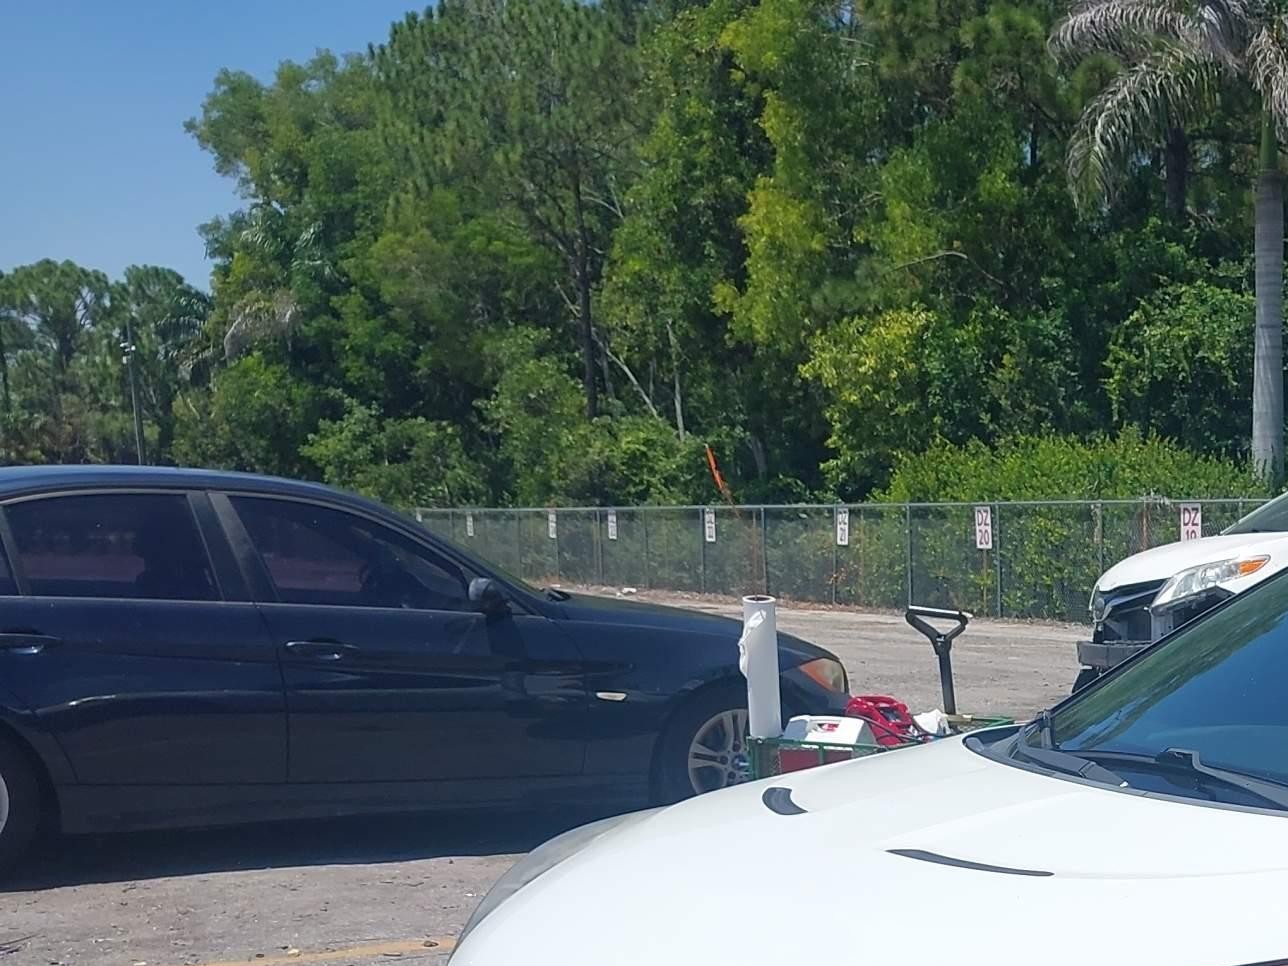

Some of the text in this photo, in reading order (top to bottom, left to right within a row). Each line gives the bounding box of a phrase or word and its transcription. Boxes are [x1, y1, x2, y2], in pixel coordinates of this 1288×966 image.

[976, 509, 990, 527] DZ
[1183, 507, 1200, 527] DZ
[978, 529, 990, 546] 20
